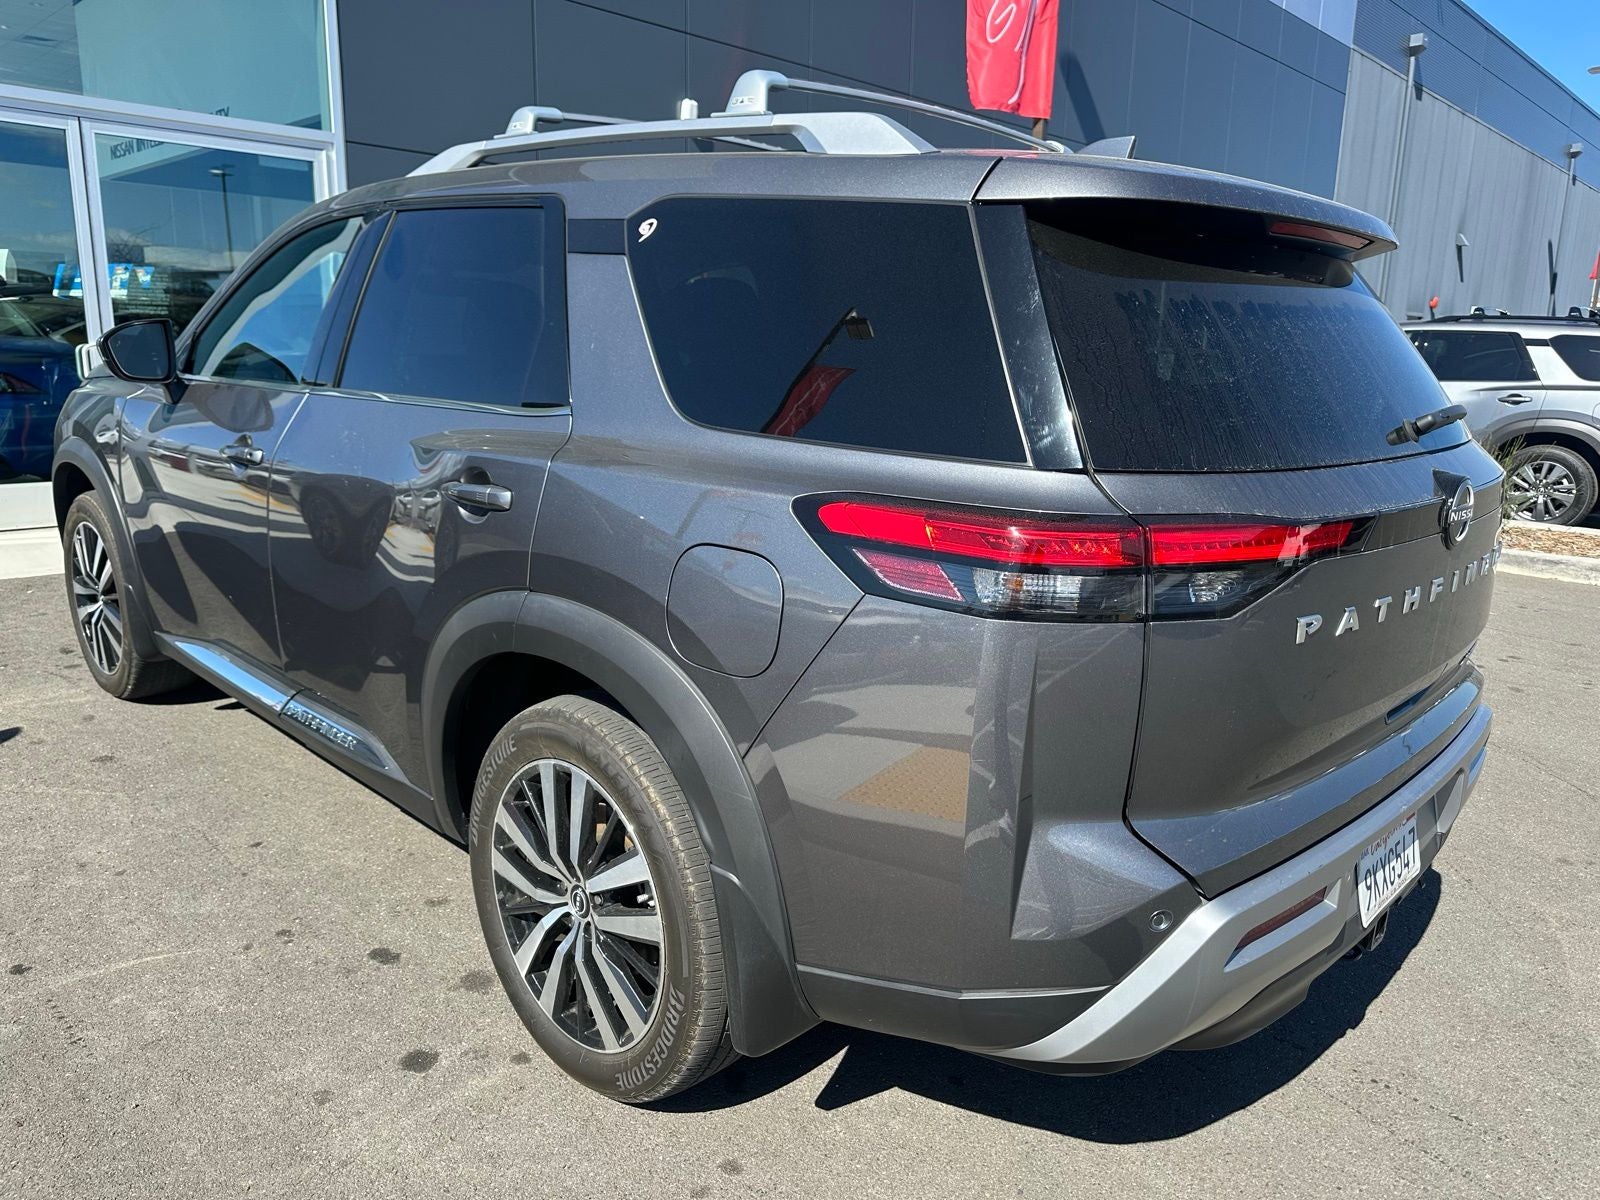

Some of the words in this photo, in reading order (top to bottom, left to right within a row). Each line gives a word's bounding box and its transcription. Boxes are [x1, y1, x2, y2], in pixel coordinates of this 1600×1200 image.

[1450, 508, 1473, 522] NISS
[1364, 826, 1416, 912] 9KXG547
[615, 981, 686, 1091] BRIDGESTONE
